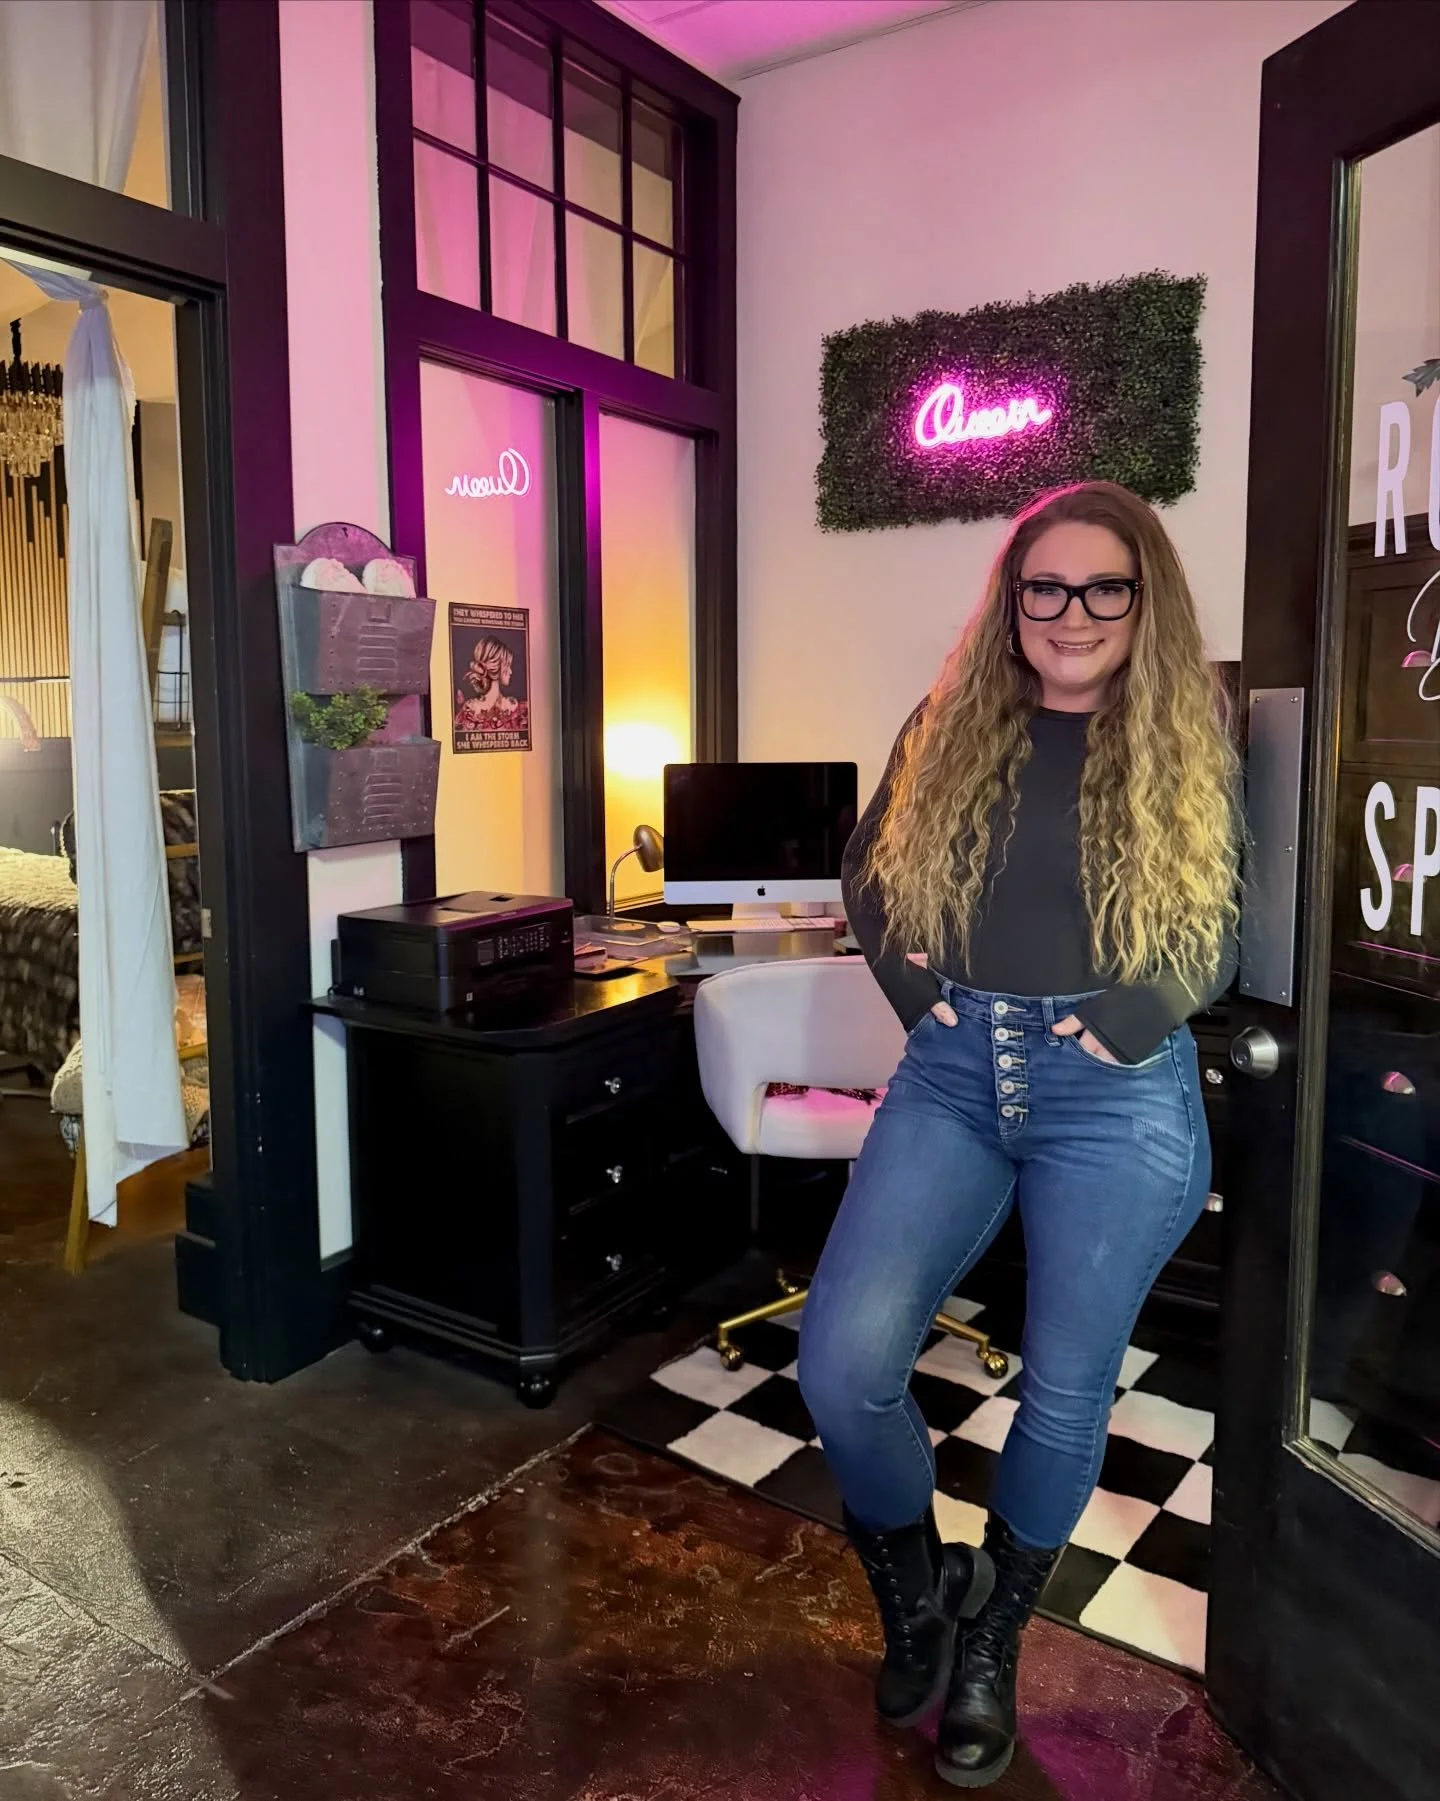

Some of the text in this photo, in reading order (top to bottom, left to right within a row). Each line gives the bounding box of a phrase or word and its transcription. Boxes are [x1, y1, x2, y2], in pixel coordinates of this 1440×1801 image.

[504, 612, 512, 621] TO
[470, 733, 482, 741] AM
[484, 732, 496, 741] THE
[498, 732, 520, 740] STORM
[456, 739, 528, 750] SHE WHISPERED BACK
